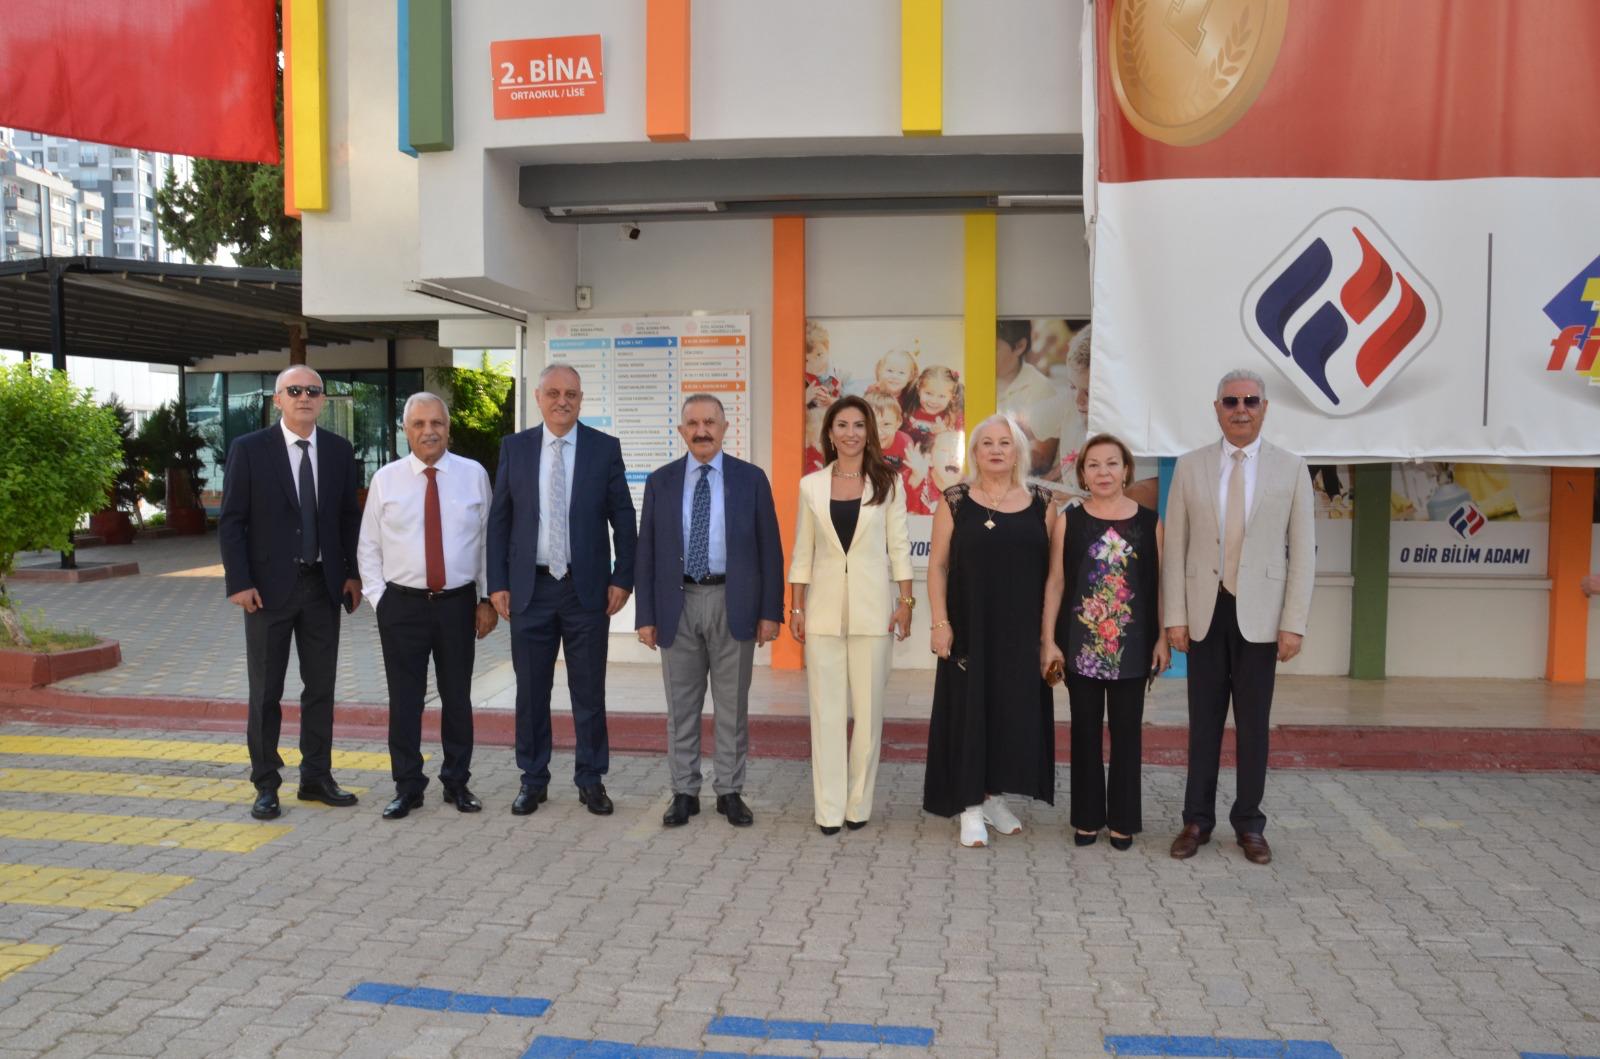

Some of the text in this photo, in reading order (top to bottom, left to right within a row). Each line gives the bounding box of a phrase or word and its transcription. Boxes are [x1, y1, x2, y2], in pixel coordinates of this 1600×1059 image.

[500, 53, 594, 84] 2. BİNA
[511, 90, 560, 100] ORTAOKUL
[1400, 544, 1530, 564] O BİR BİLİM ADAMI
